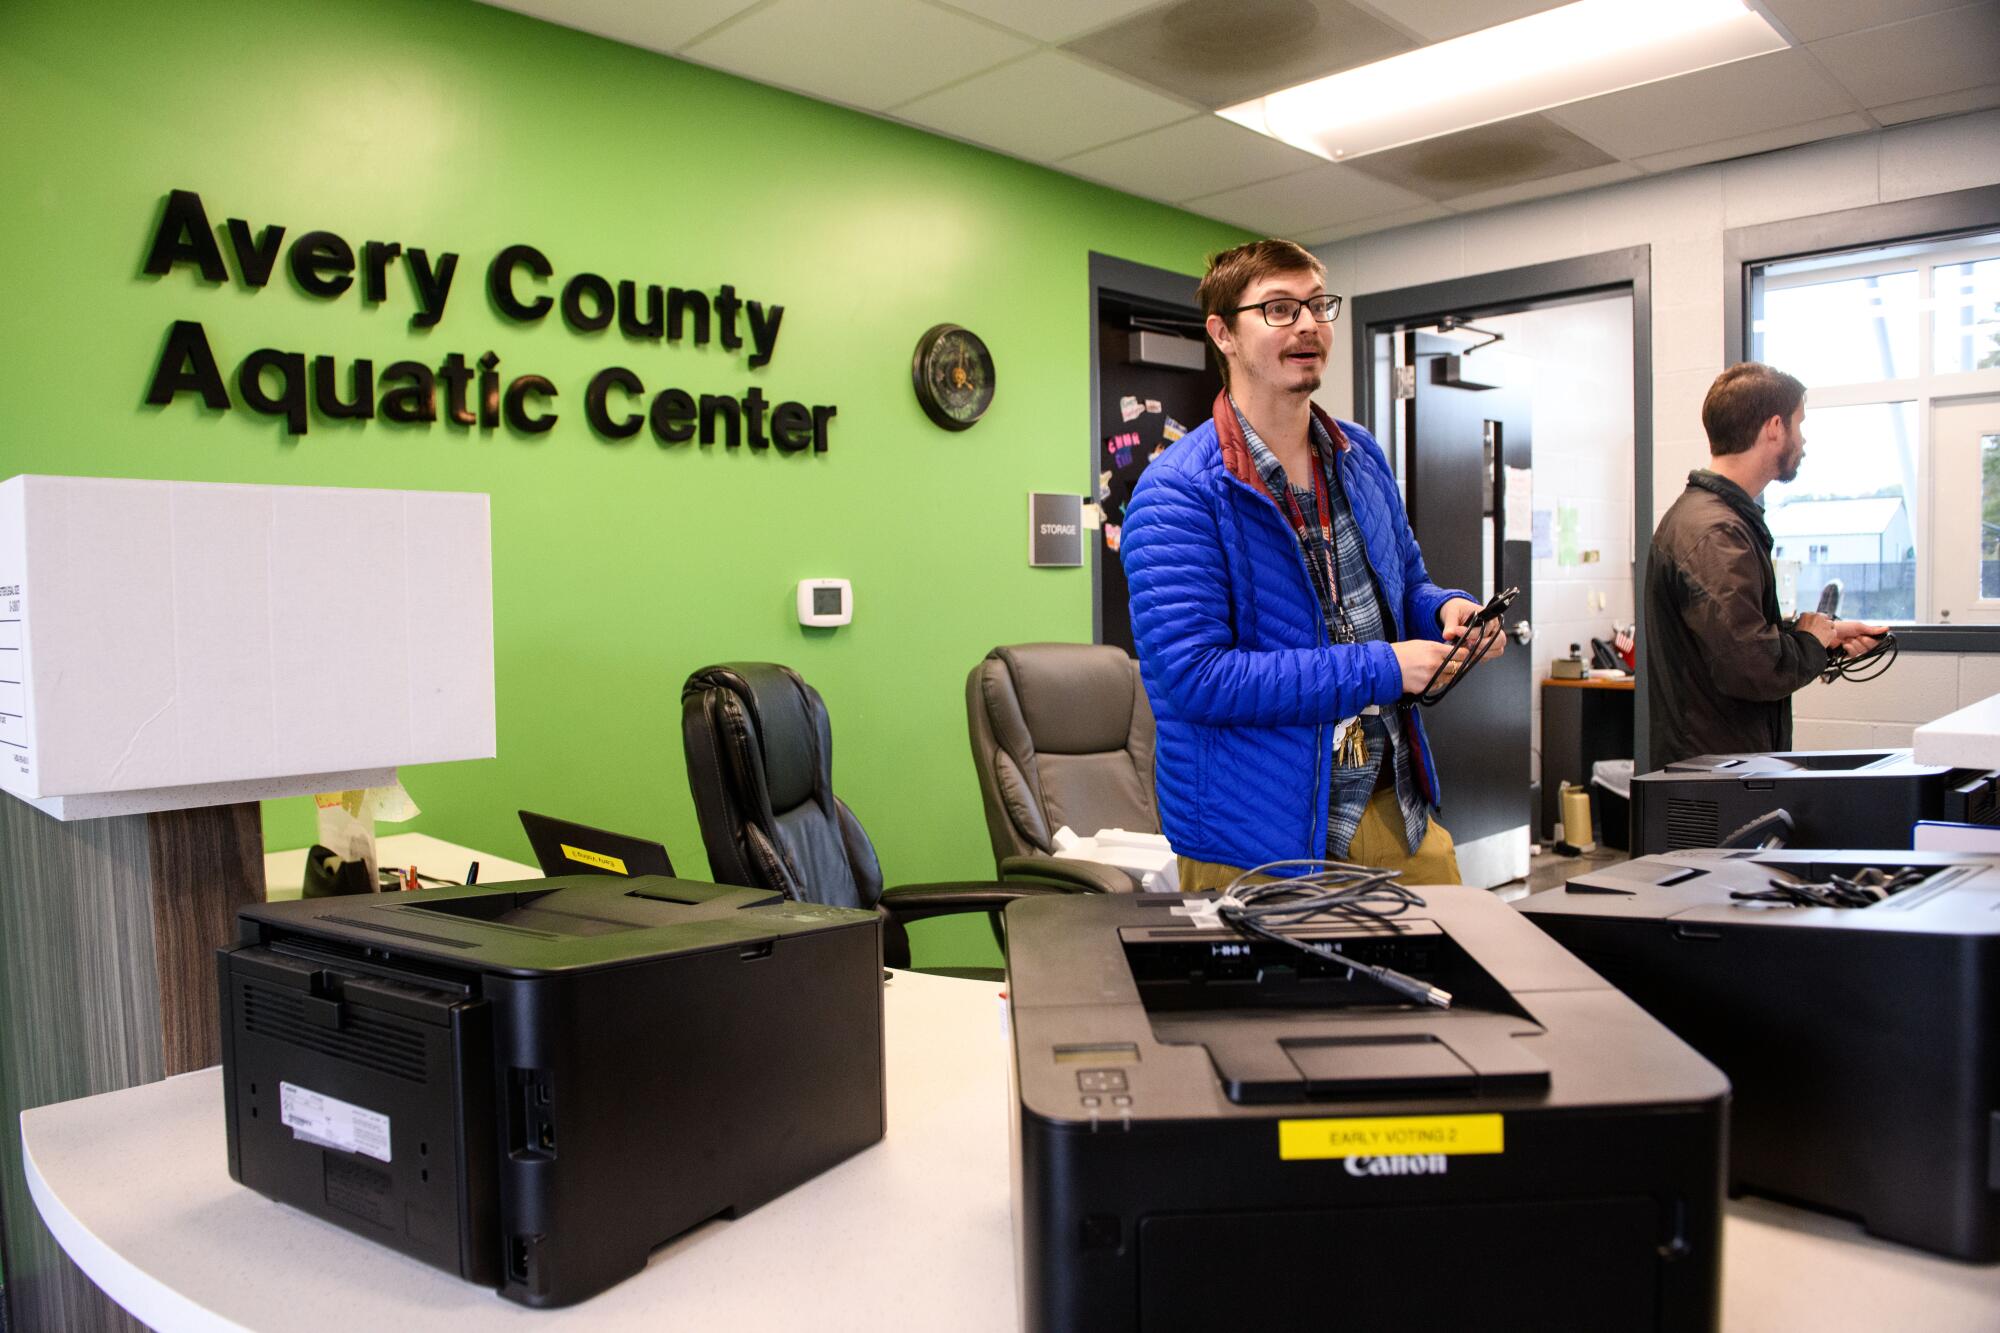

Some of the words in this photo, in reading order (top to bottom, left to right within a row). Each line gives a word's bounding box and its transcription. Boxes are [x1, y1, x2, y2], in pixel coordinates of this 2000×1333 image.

[144, 189, 459, 328] Avery
[489, 244, 784, 368] County
[147, 320, 559, 435] Aquatic
[585, 367, 837, 453] Center
[1040, 524, 1076, 535] STORAGE
[1330, 1130, 1380, 1145] EARLY
[1386, 1128, 1445, 1144] VOTING
[1447, 1127, 1458, 1141] 2
[1344, 1154, 1448, 1176] Canon
